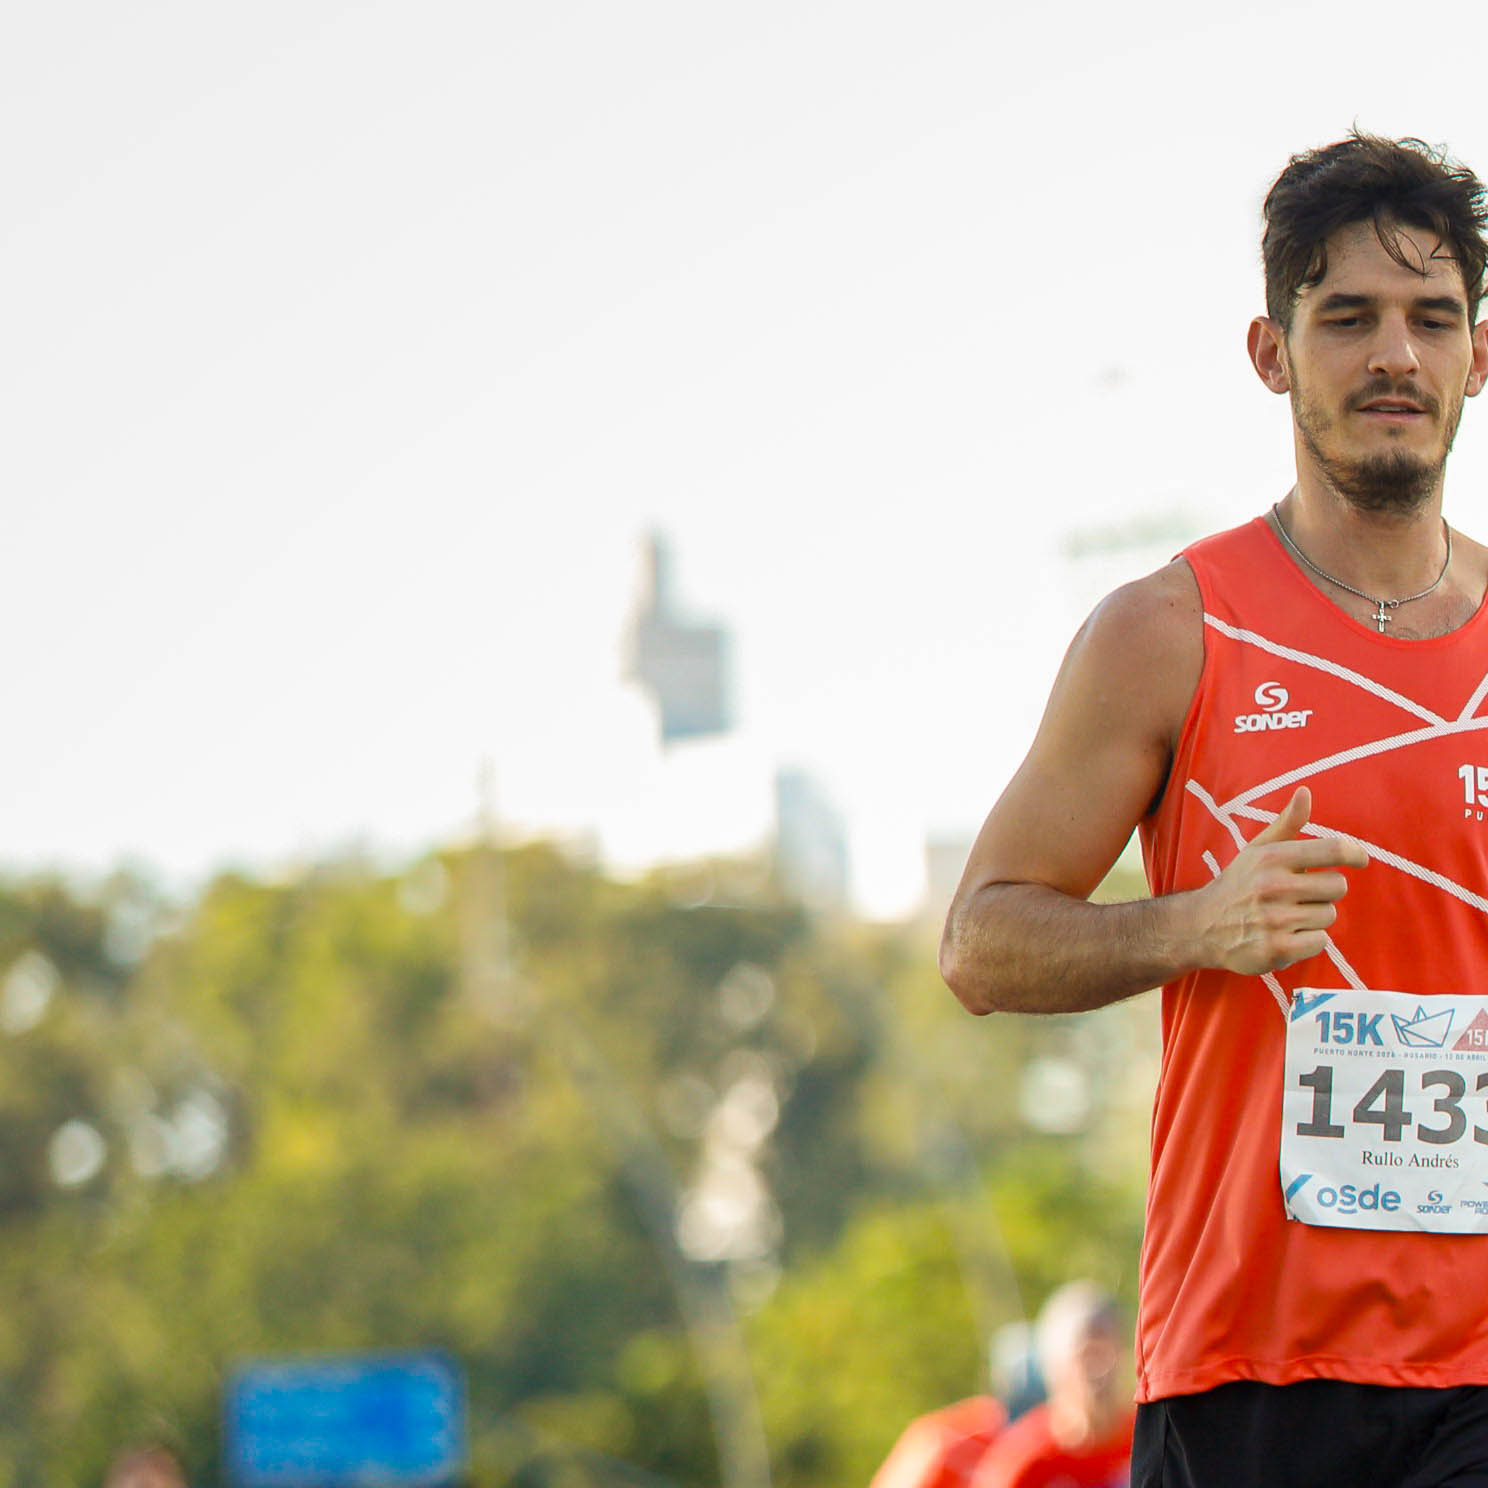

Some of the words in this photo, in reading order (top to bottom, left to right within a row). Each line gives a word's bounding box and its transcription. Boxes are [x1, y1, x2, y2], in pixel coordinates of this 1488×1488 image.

[1315, 1011, 1385, 1046] 15K
[1313, 1047, 1345, 1056] PUERTO
[1348, 1049, 1374, 1057] NORTE
[1361, 1150, 1403, 1167] Rullo
[1407, 1153, 1460, 1168] Andrés
